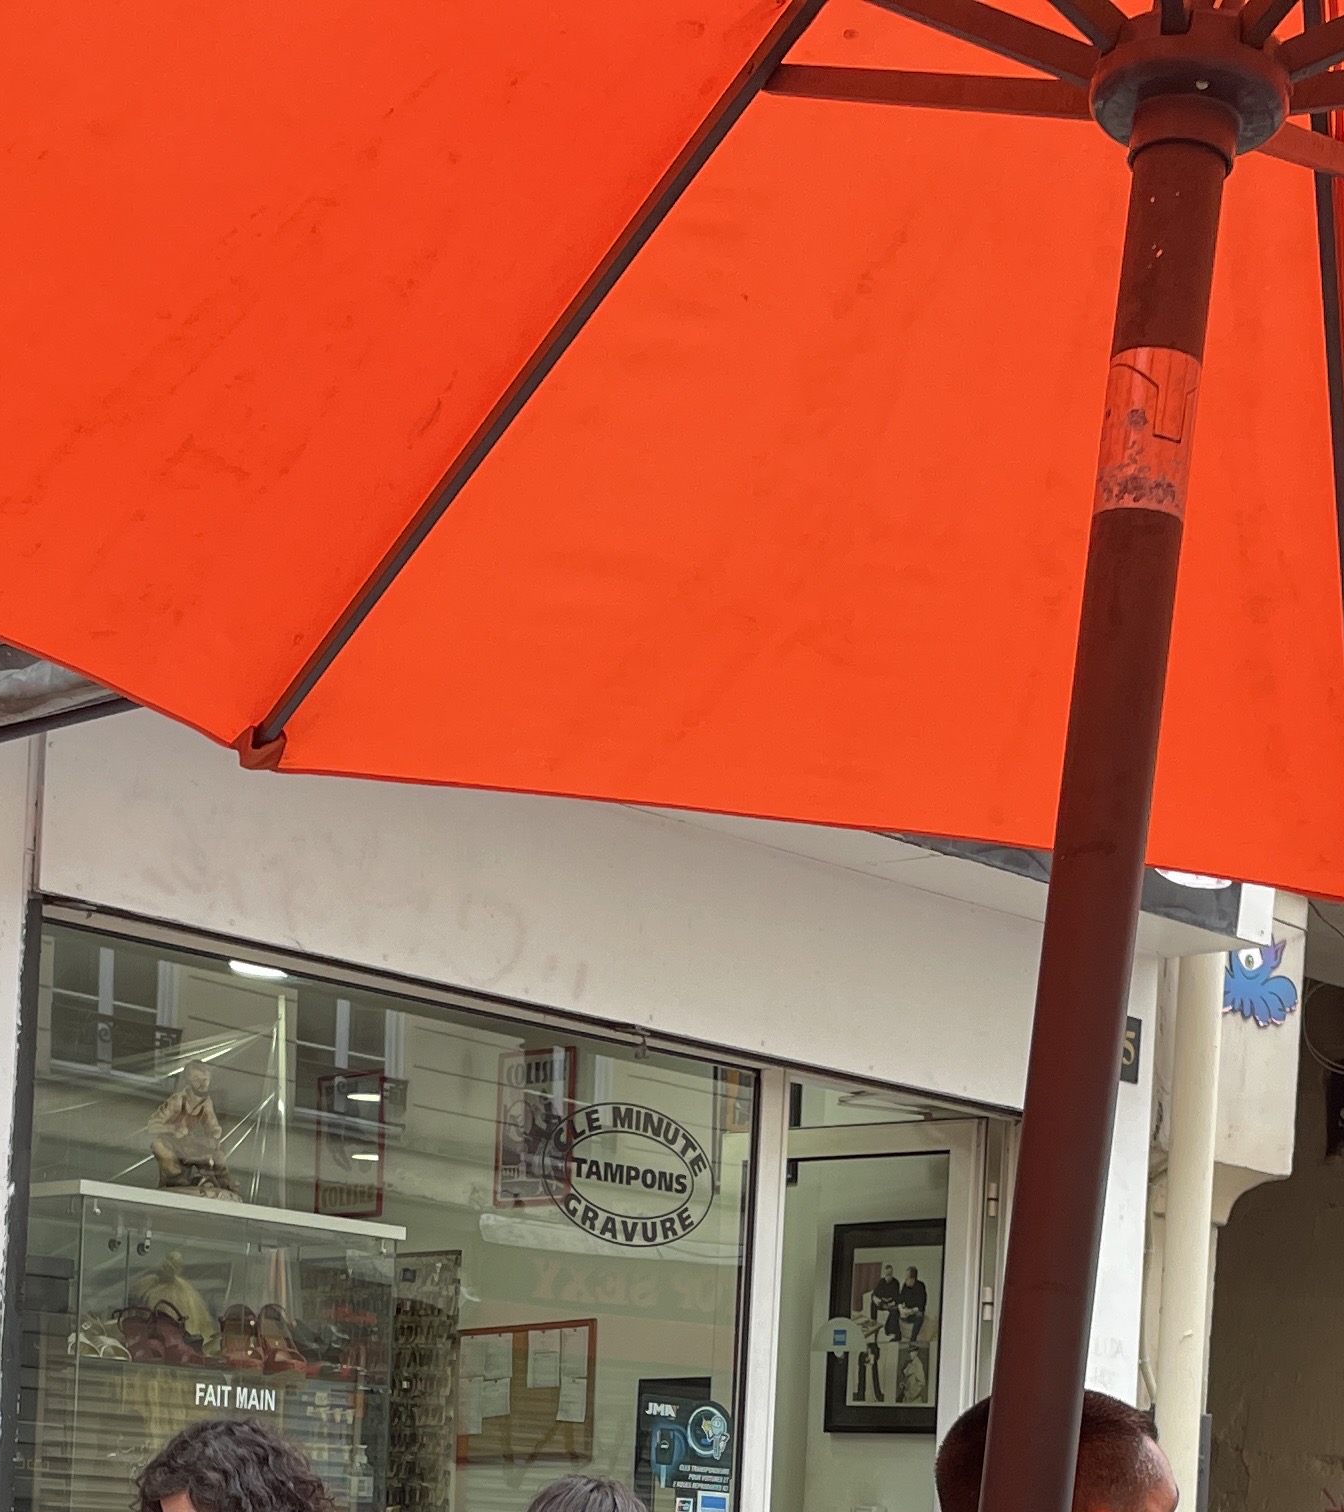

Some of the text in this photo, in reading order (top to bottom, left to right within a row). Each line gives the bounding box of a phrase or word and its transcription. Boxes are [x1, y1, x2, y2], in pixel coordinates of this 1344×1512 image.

[553, 1105, 708, 1178] CLE MINUTE
[570, 1156, 688, 1195] TAMPONS
[563, 1193, 695, 1243] GRAVURE
[194, 1382, 276, 1412] FAIT MAIN
